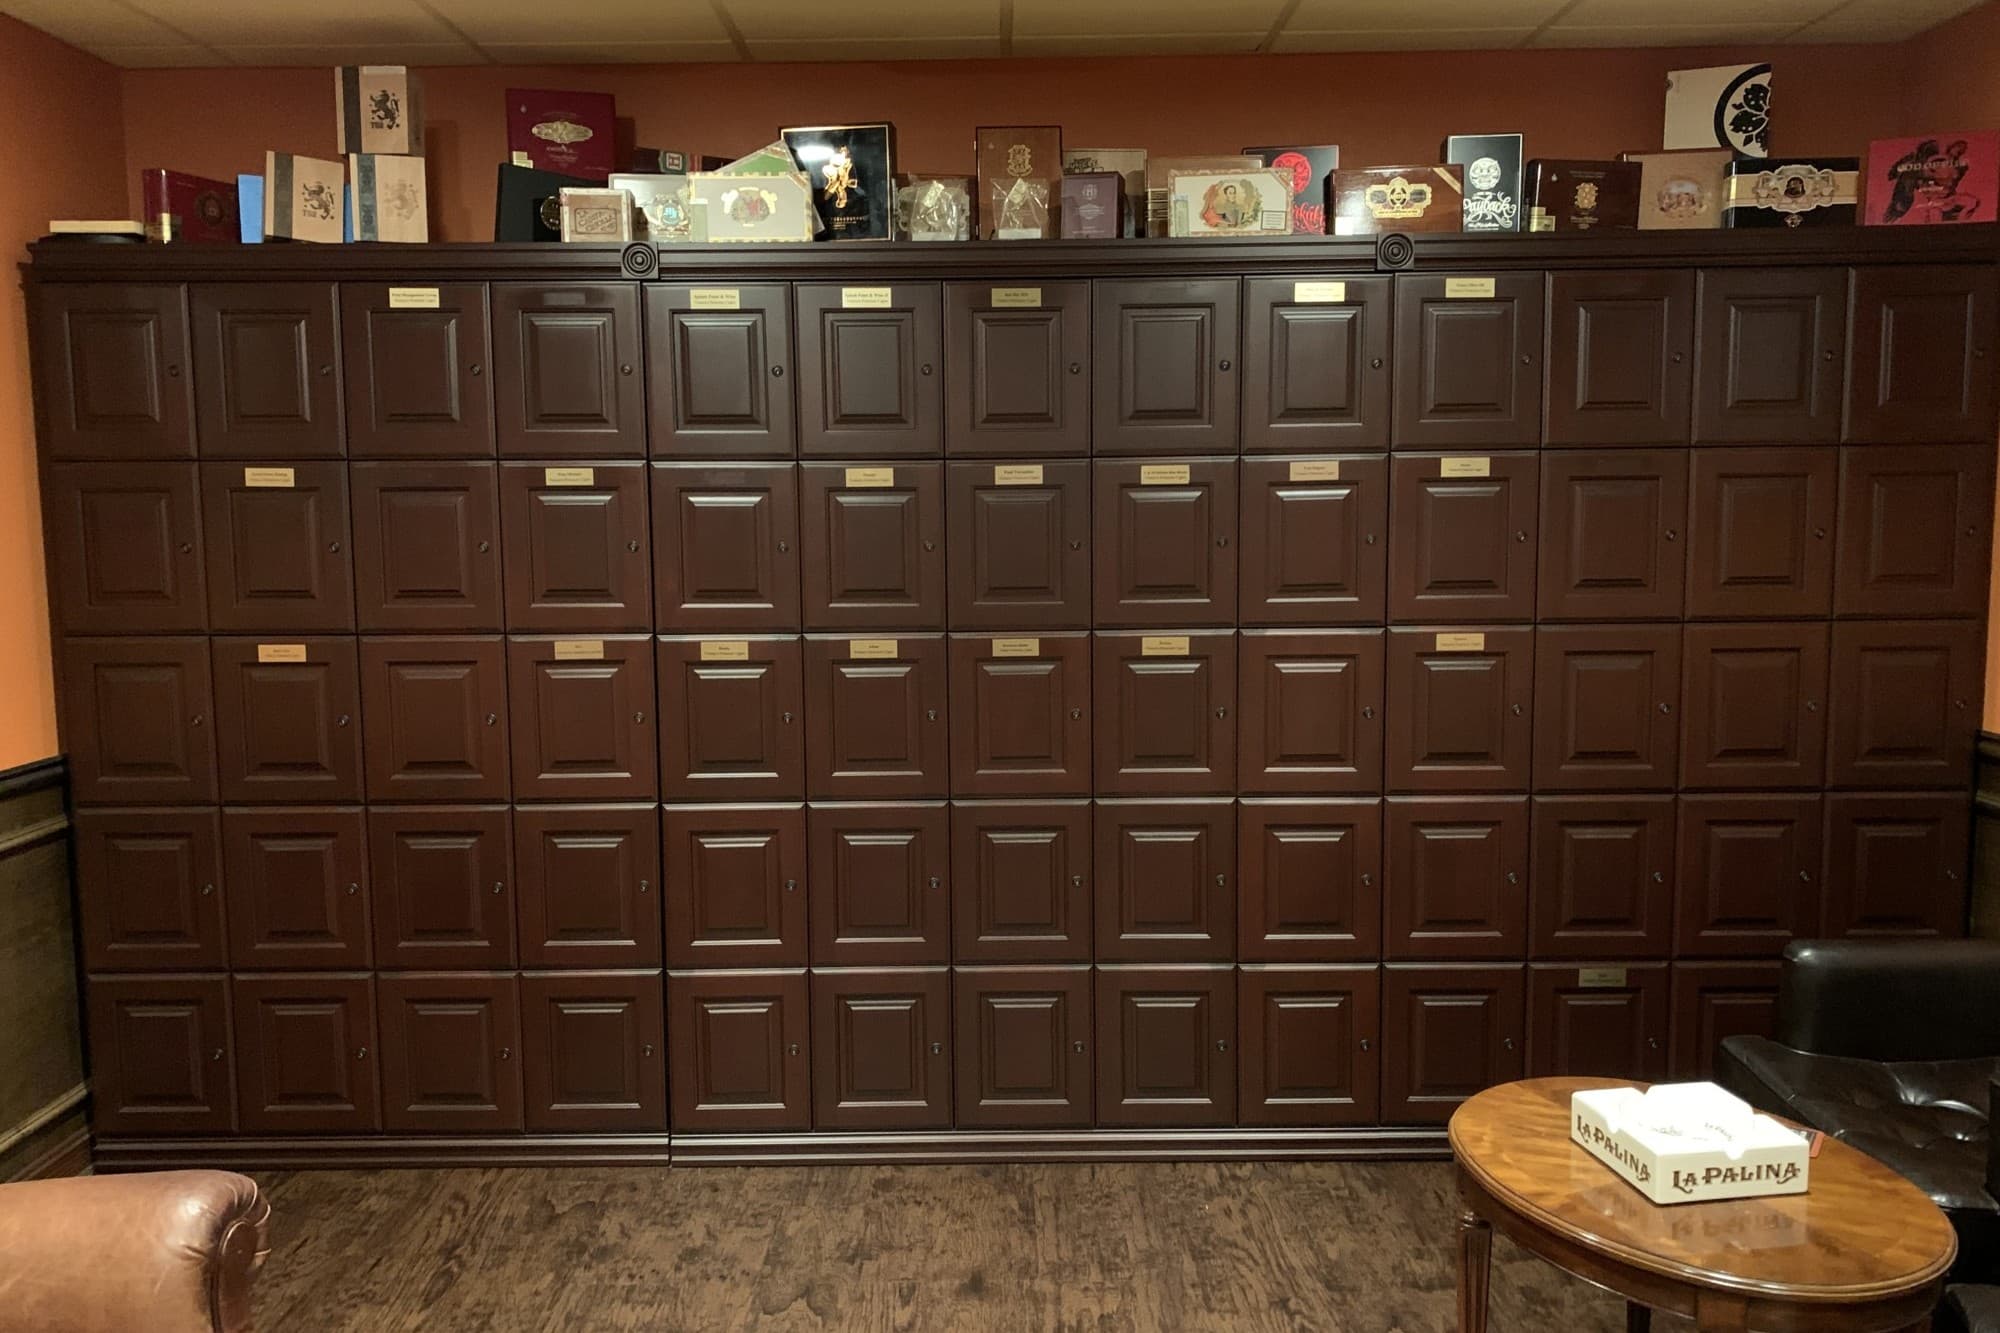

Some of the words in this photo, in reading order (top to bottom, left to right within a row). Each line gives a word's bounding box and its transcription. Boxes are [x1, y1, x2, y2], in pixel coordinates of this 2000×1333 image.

[1463, 195, 1517, 224] Payback
[1593, 1126, 1651, 1183] PALINA
[1672, 1170, 1699, 1194] LA
[1701, 1162, 1800, 1185] PALINA
